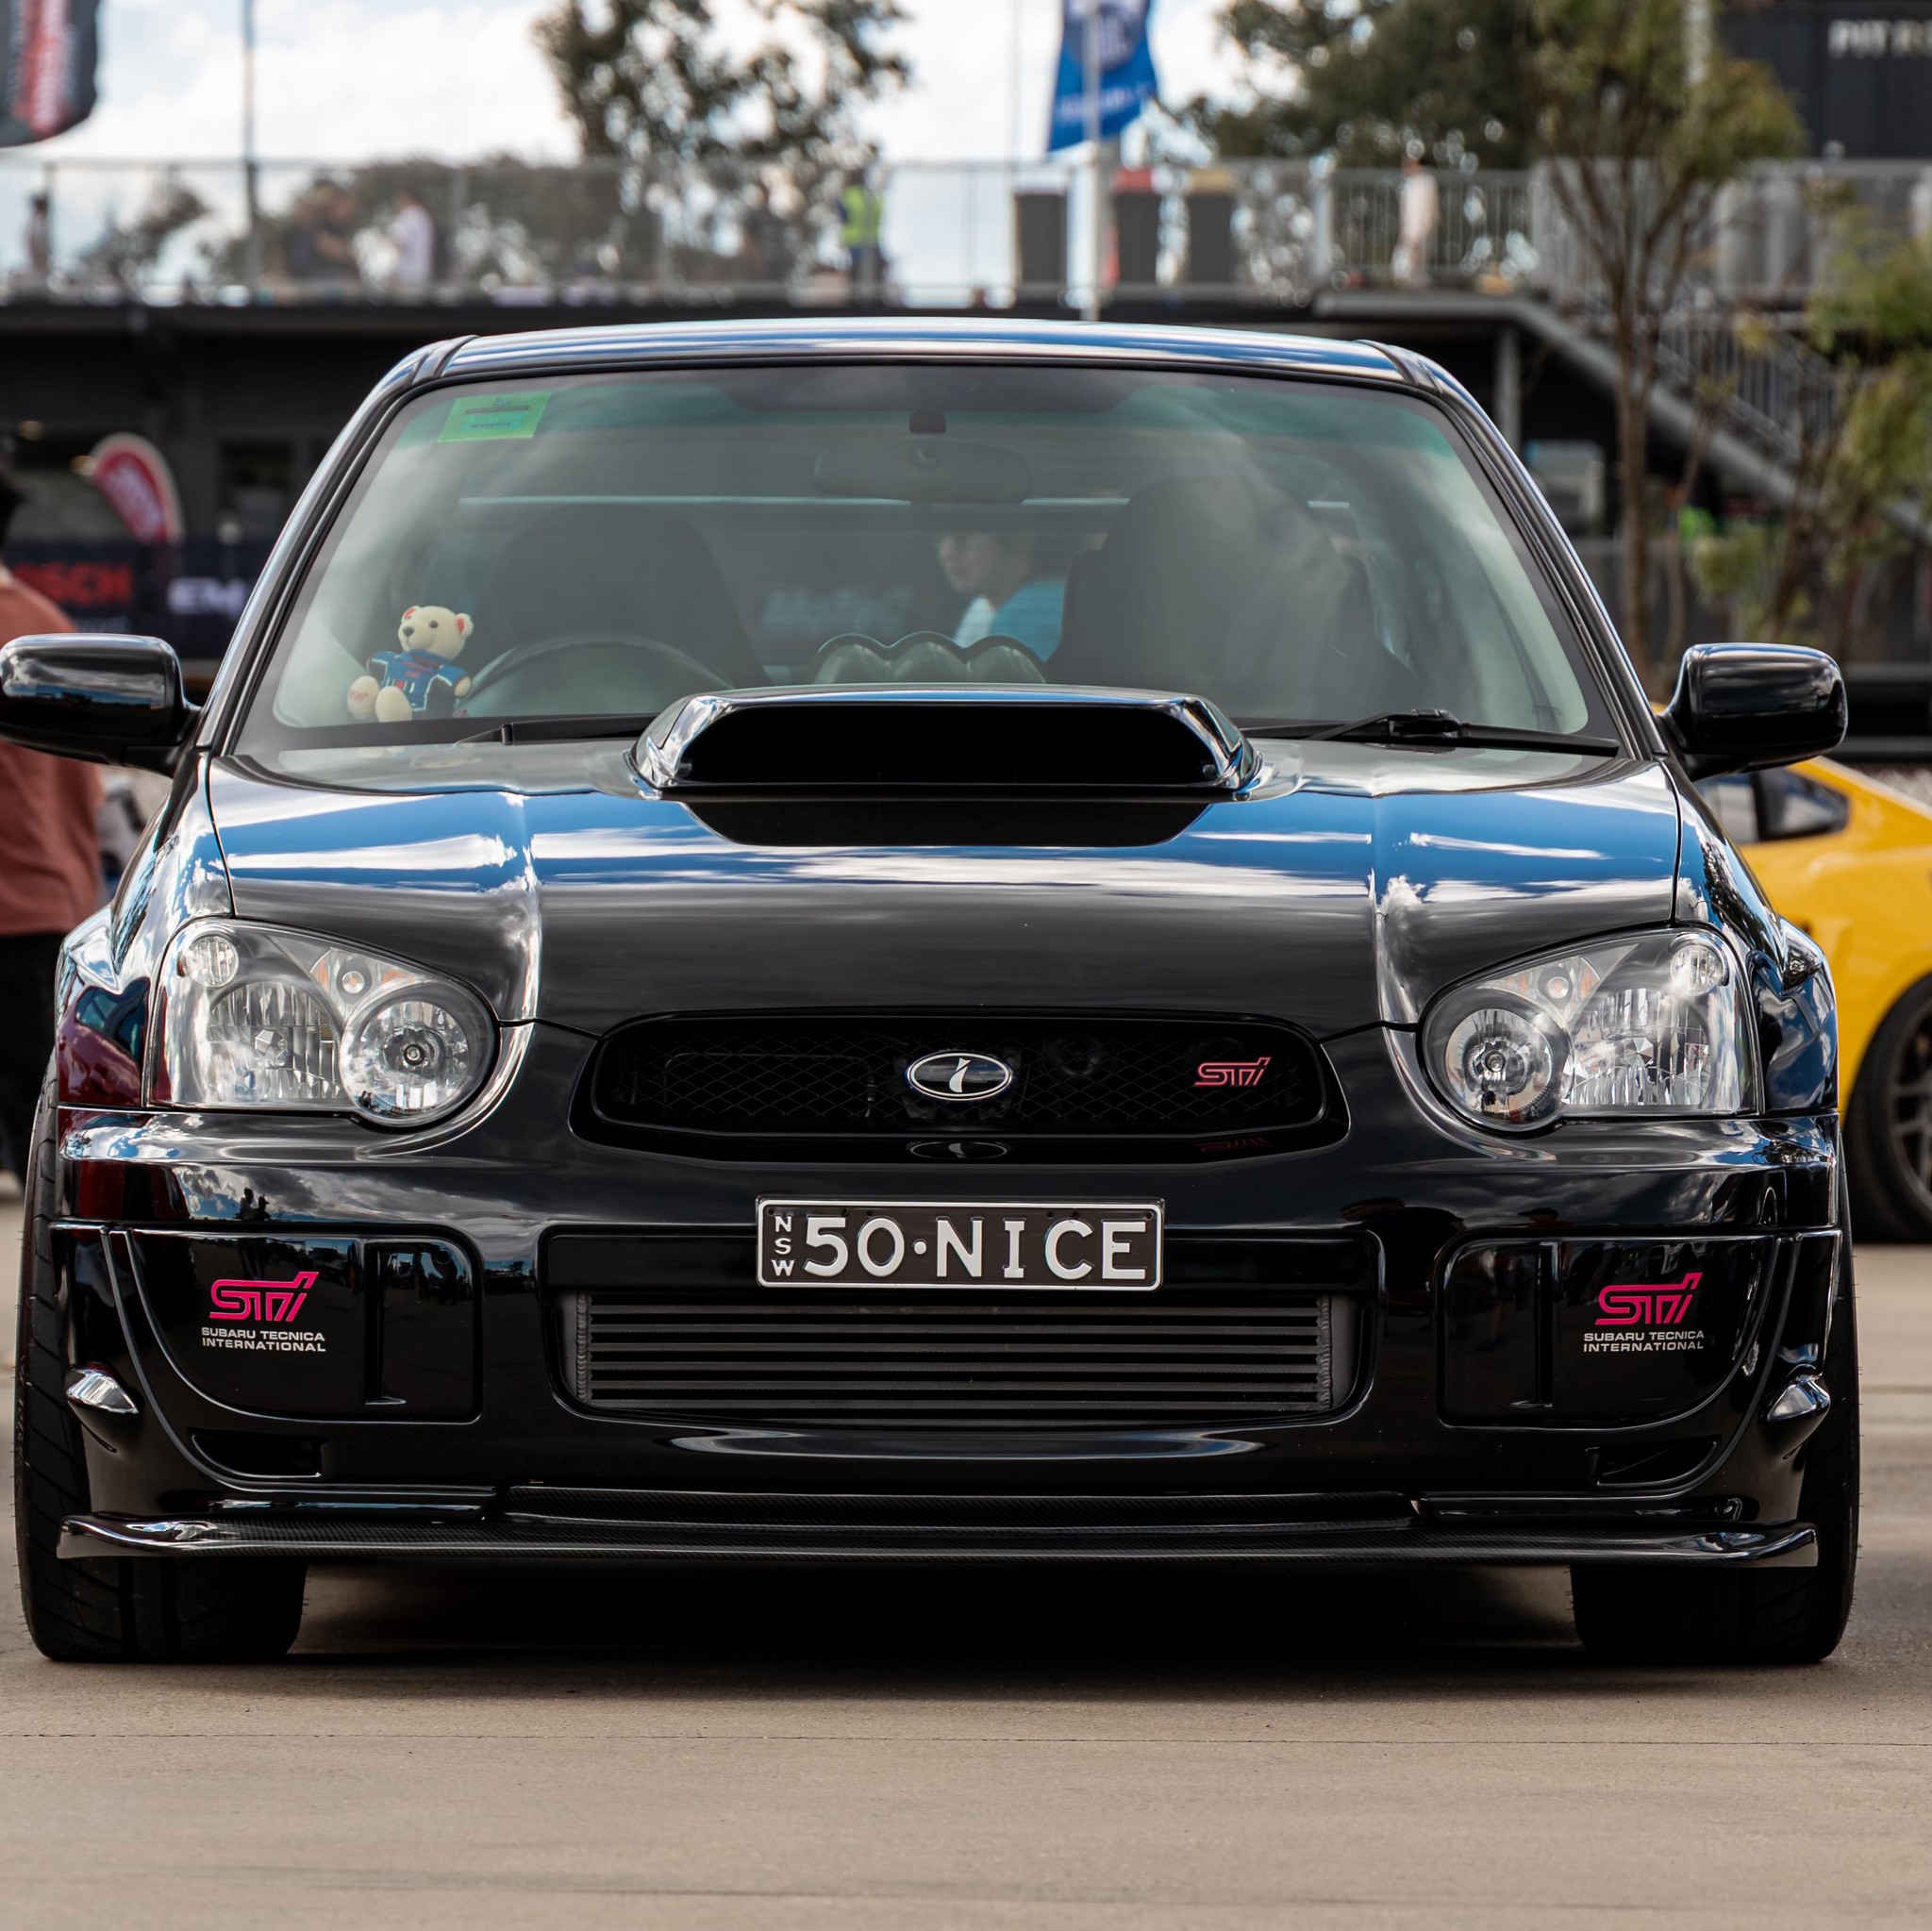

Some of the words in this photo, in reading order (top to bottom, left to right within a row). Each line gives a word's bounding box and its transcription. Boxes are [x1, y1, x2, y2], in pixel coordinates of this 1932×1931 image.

[201, 1327, 257, 1340] SUBARU
[259, 1330, 325, 1341] TECNICA
[1584, 1332, 1645, 1342] SUBARU
[1649, 1330, 1705, 1340] TECNICA
[202, 1338, 326, 1353] INTERNATIONAL
[1583, 1341, 1705, 1353] INTERNATIONAL
